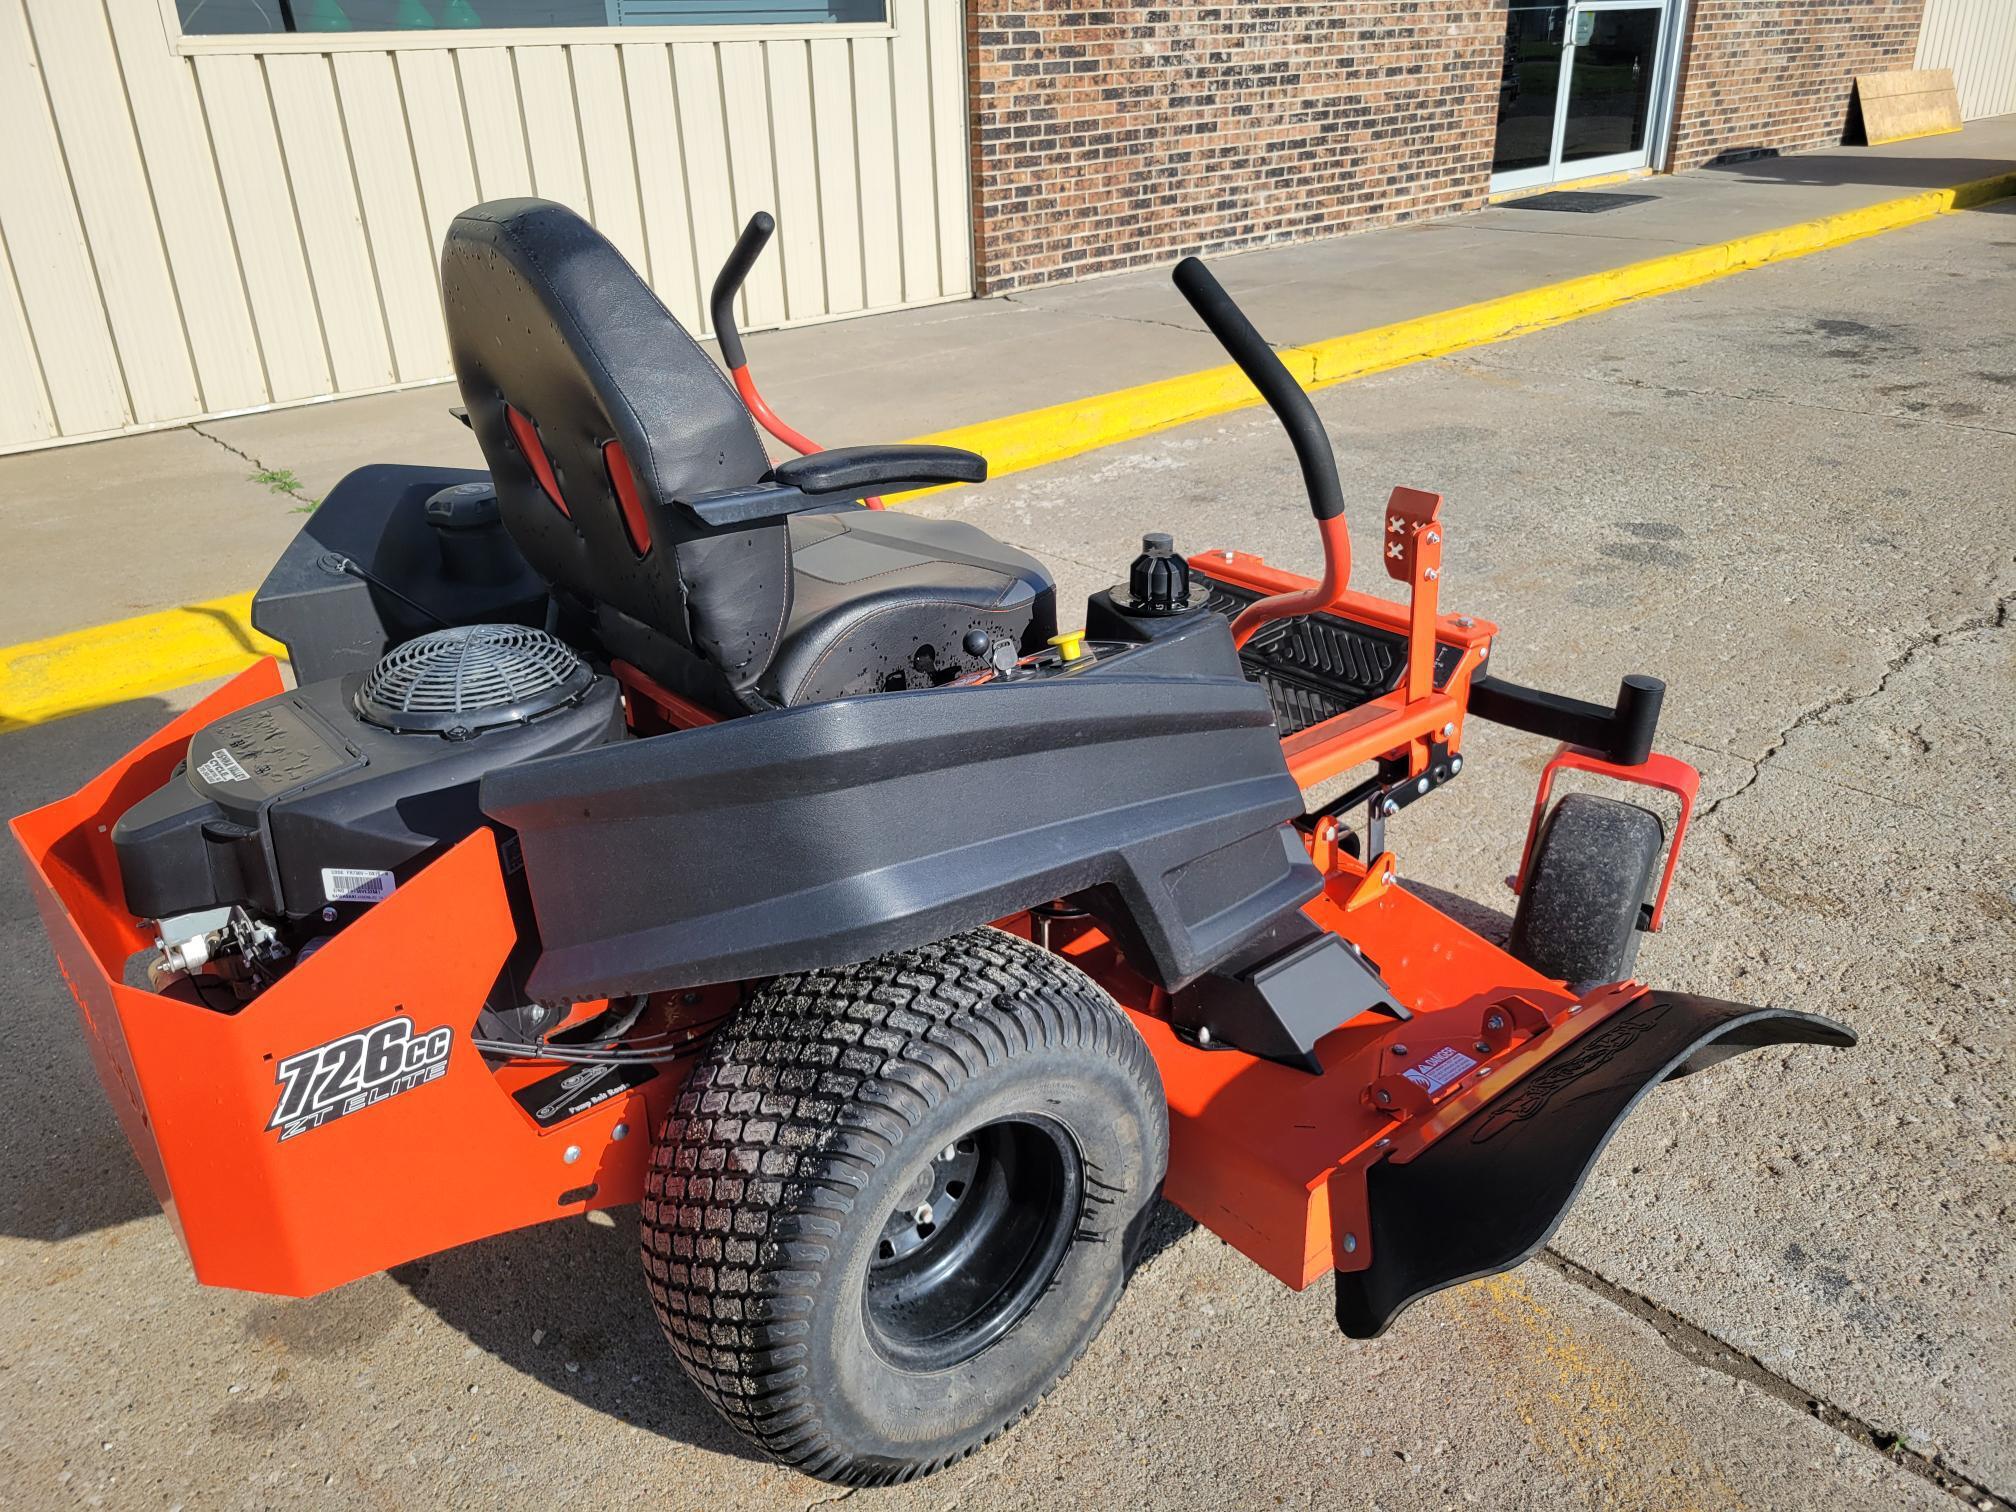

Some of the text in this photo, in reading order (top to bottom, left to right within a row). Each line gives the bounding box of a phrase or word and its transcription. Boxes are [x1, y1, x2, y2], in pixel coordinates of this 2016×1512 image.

[271, 1017, 451, 1127] 726cc
[281, 1060, 447, 1140] ZT ELITE
